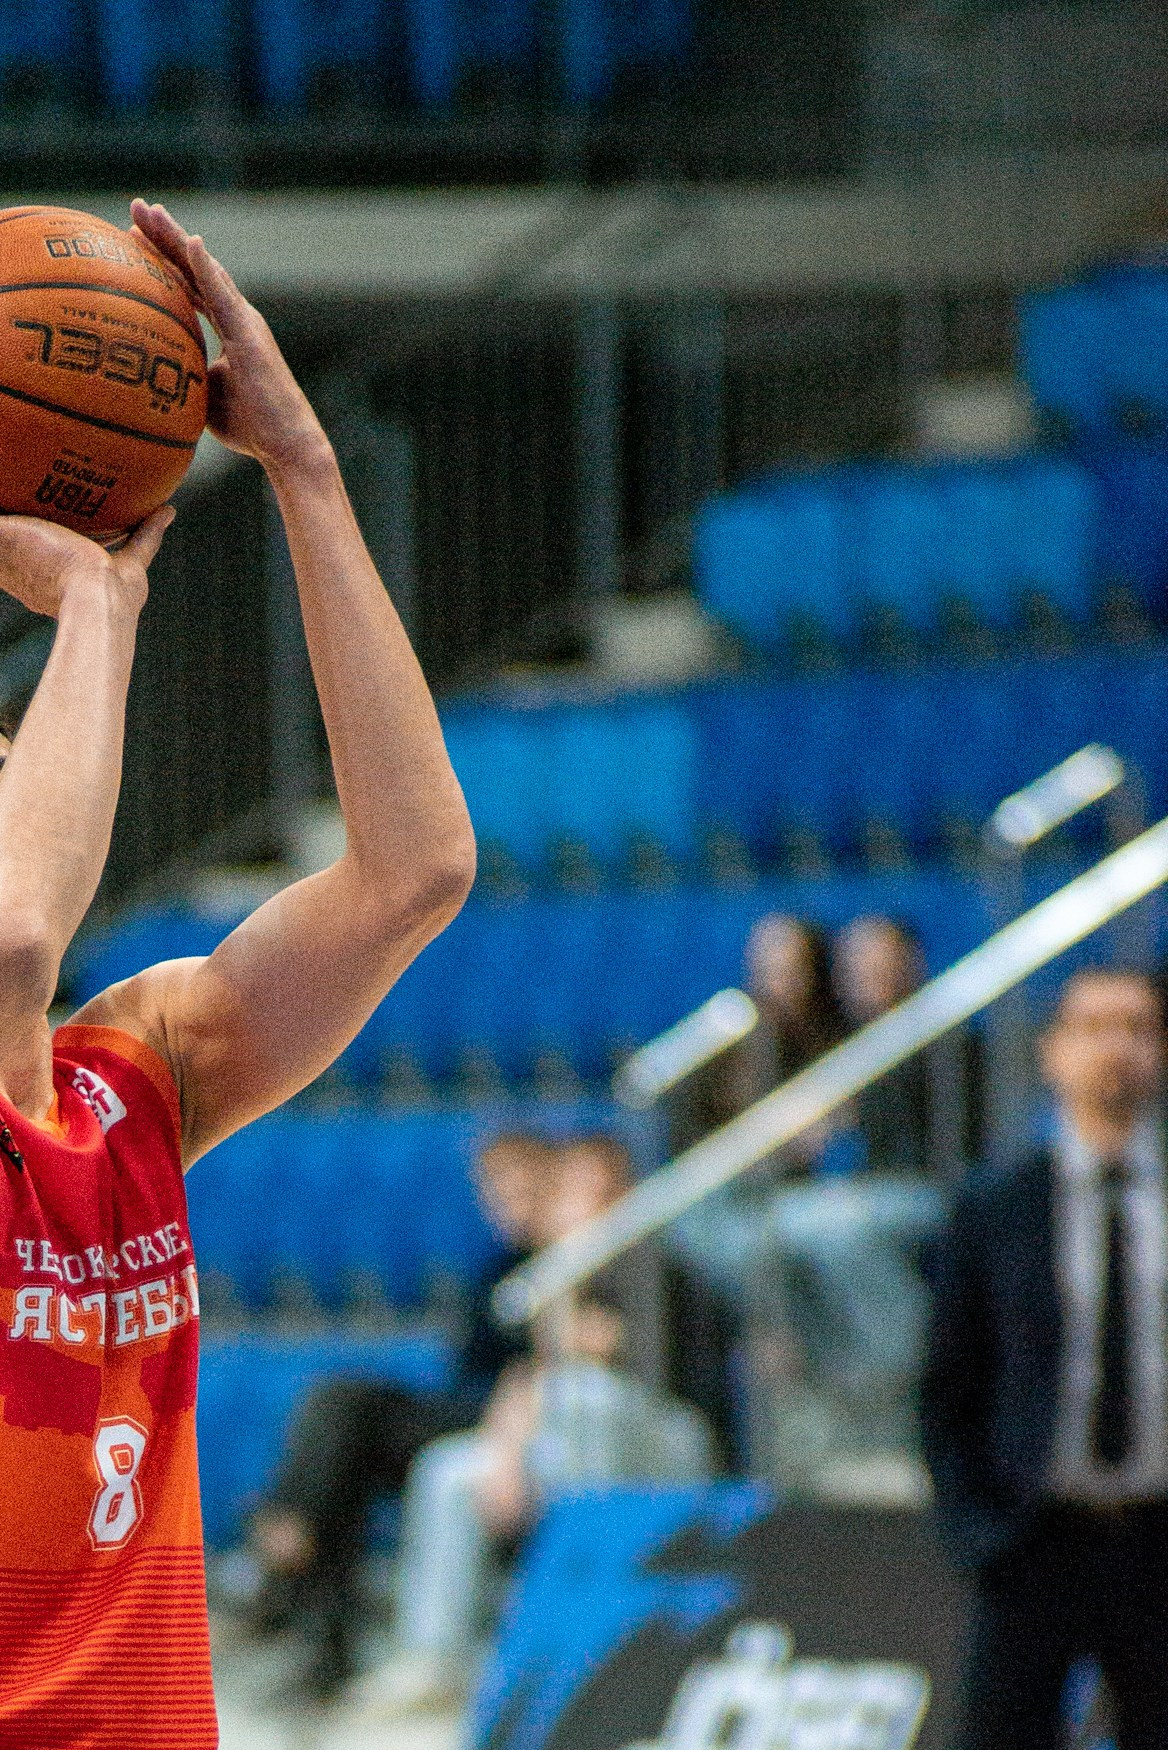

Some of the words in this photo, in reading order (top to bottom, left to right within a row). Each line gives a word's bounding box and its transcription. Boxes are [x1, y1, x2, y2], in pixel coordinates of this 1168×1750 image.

[60, 305, 97, 322] BALL
[35, 475, 107, 520] FIBA
[88, 1415, 148, 1550] 8
